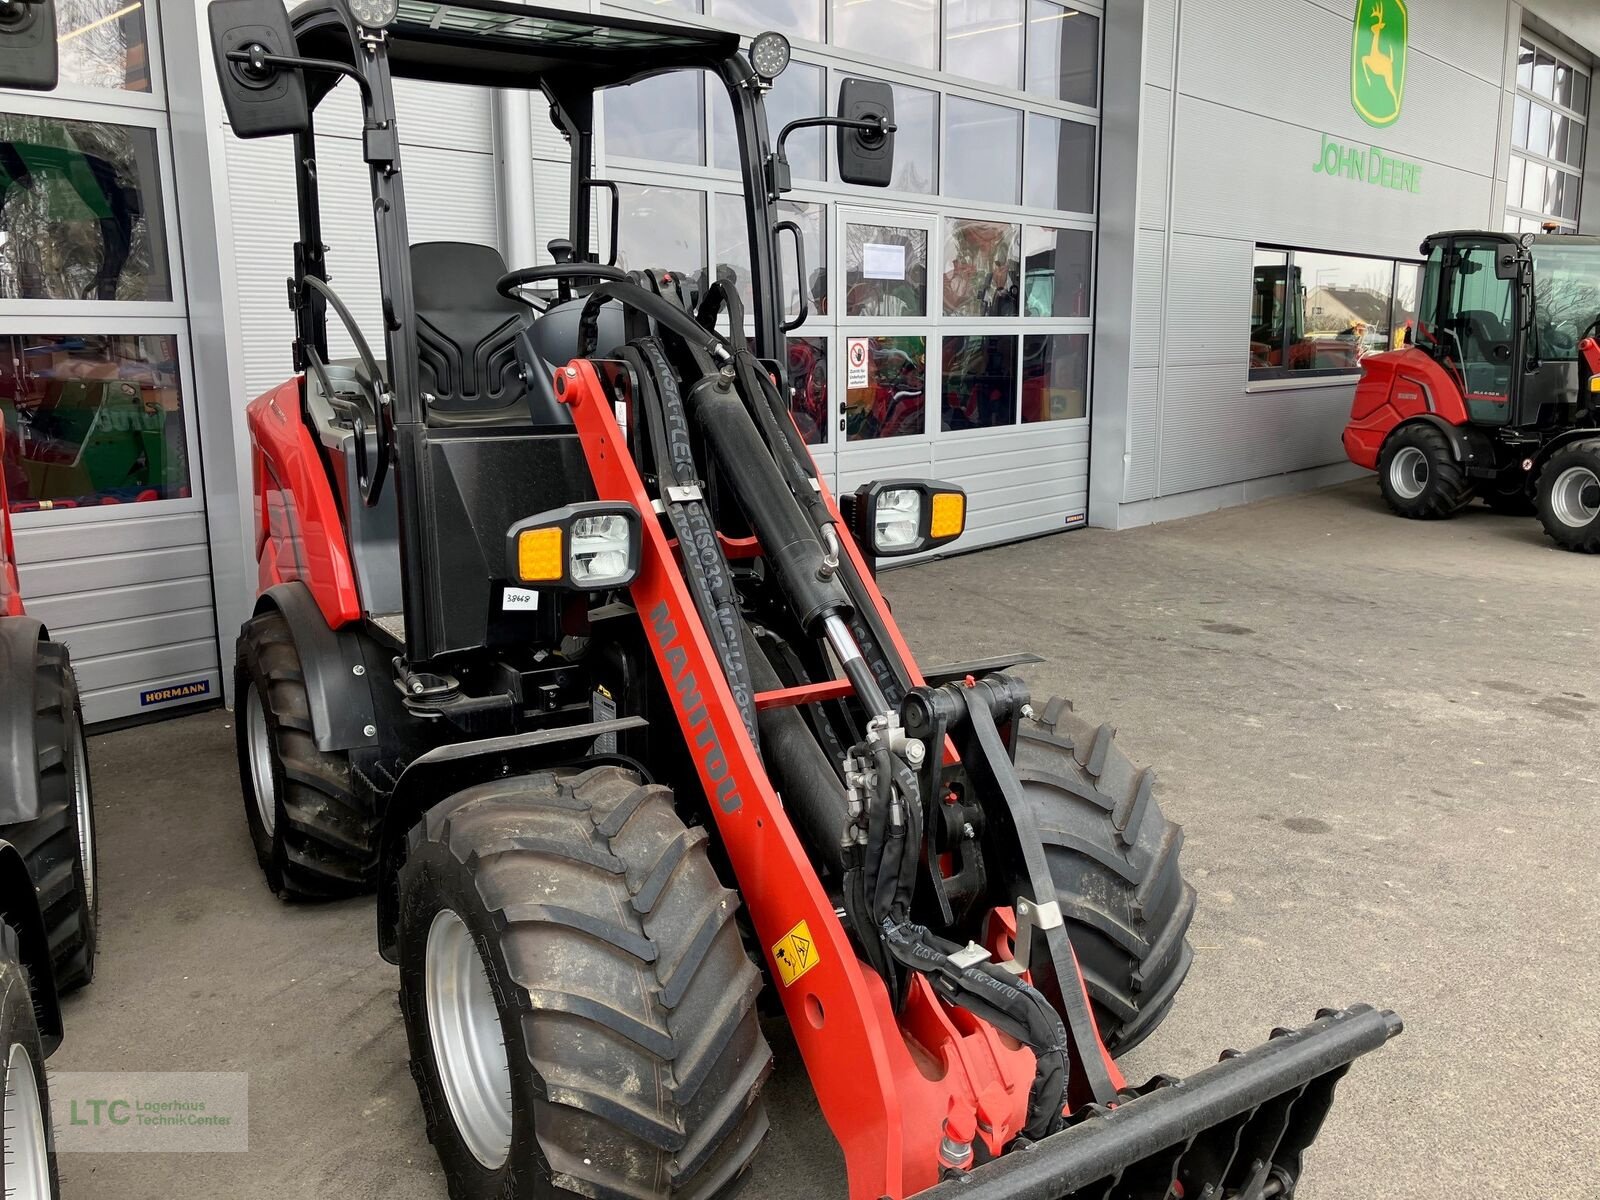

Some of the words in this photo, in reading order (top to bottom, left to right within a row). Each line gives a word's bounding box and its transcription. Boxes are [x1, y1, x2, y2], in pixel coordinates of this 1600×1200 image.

[1312, 133, 1366, 181] JOHN
[1368, 146, 1423, 193] DEERE
[650, 598, 743, 815] MANITOU
